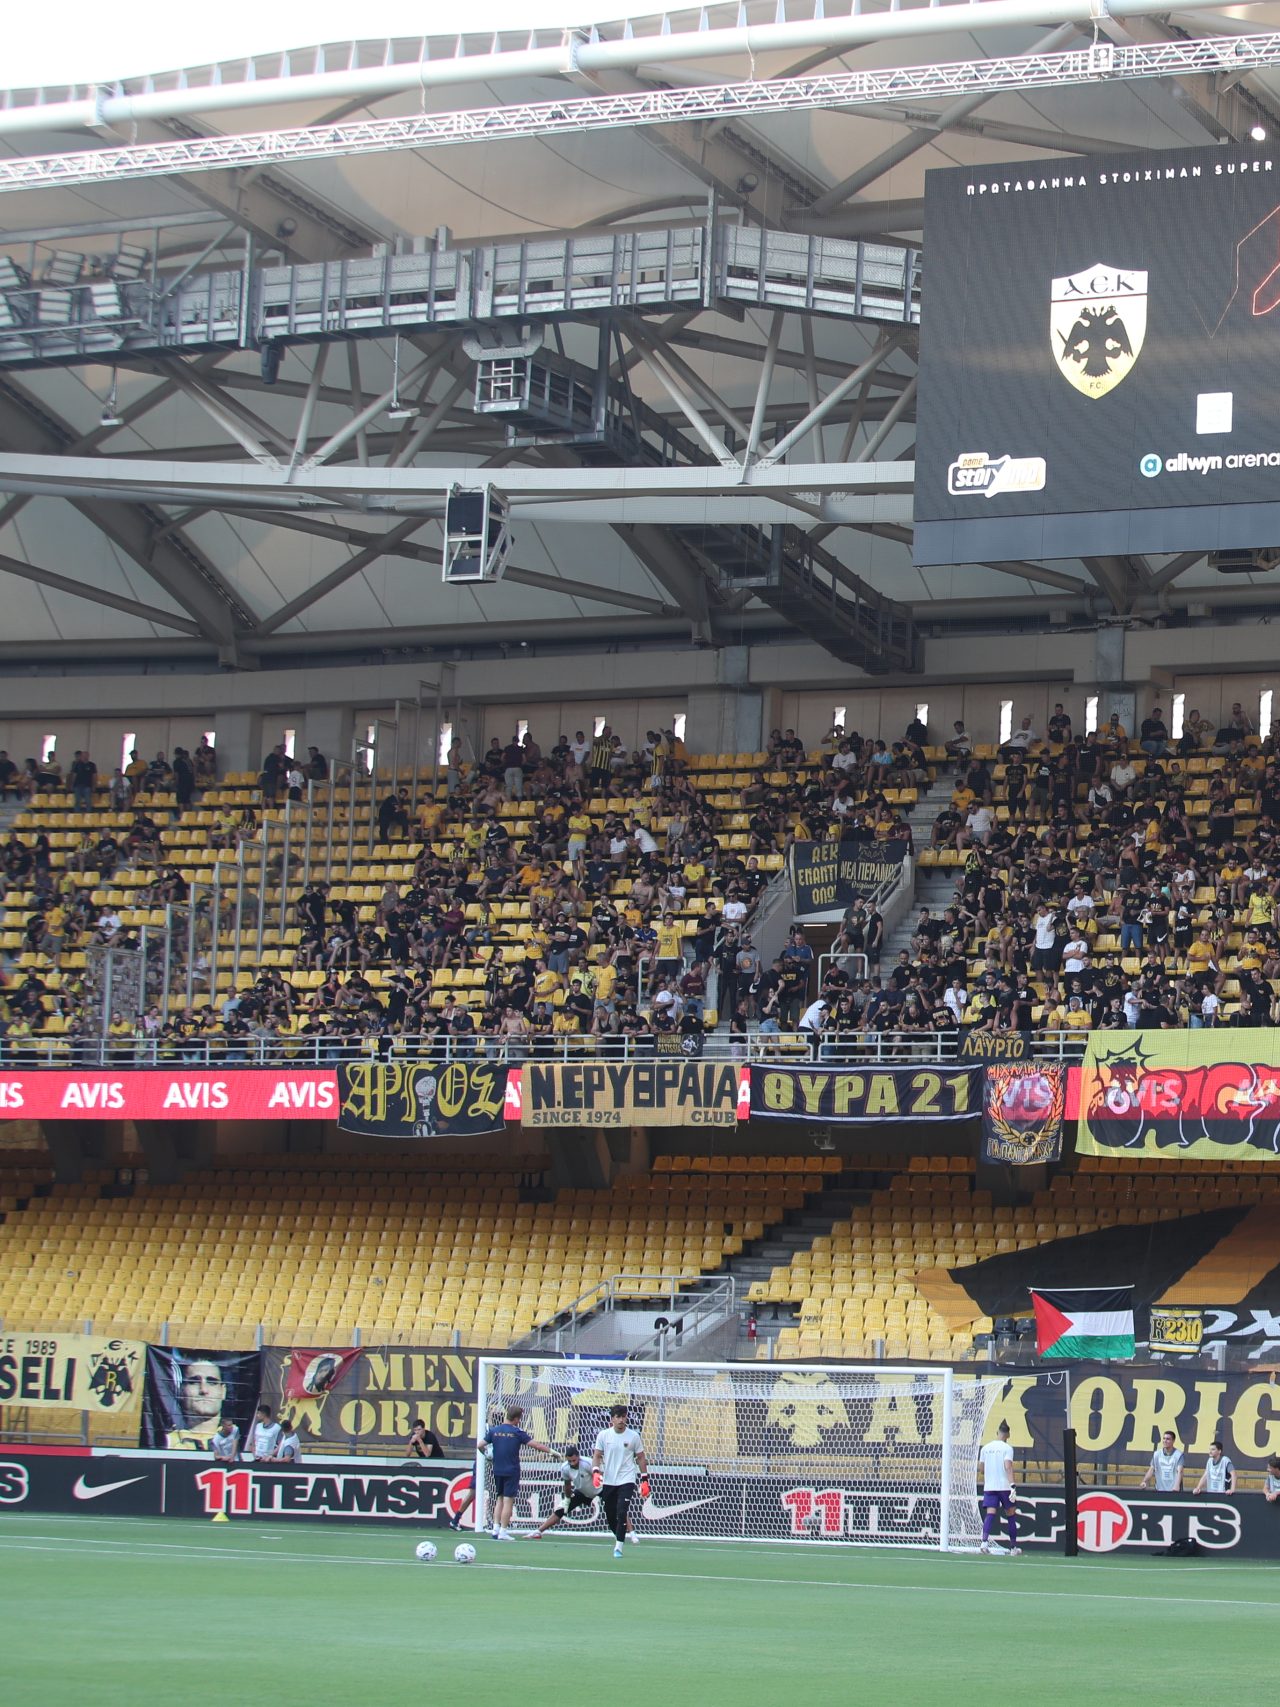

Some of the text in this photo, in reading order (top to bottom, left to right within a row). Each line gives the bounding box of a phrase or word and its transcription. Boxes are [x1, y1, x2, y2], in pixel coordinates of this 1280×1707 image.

[1099, 166, 1202, 184] STOIXIMAN
[1215, 160, 1273, 175] SUPER
[1165, 453, 1223, 475] allwyn
[1225, 452, 1280, 468] arena
[962, 1037, 1024, 1057] ΛΑΥΡΙΟ
[60, 1081, 126, 1108] AVIS
[163, 1080, 229, 1108] AVIS
[268, 1080, 335, 1108] AVIS
[911, 1072, 971, 1114] 21
[532, 1110, 736, 1125] SINCE 1974 CLUB
[26, 1340, 57, 1355] 1989
